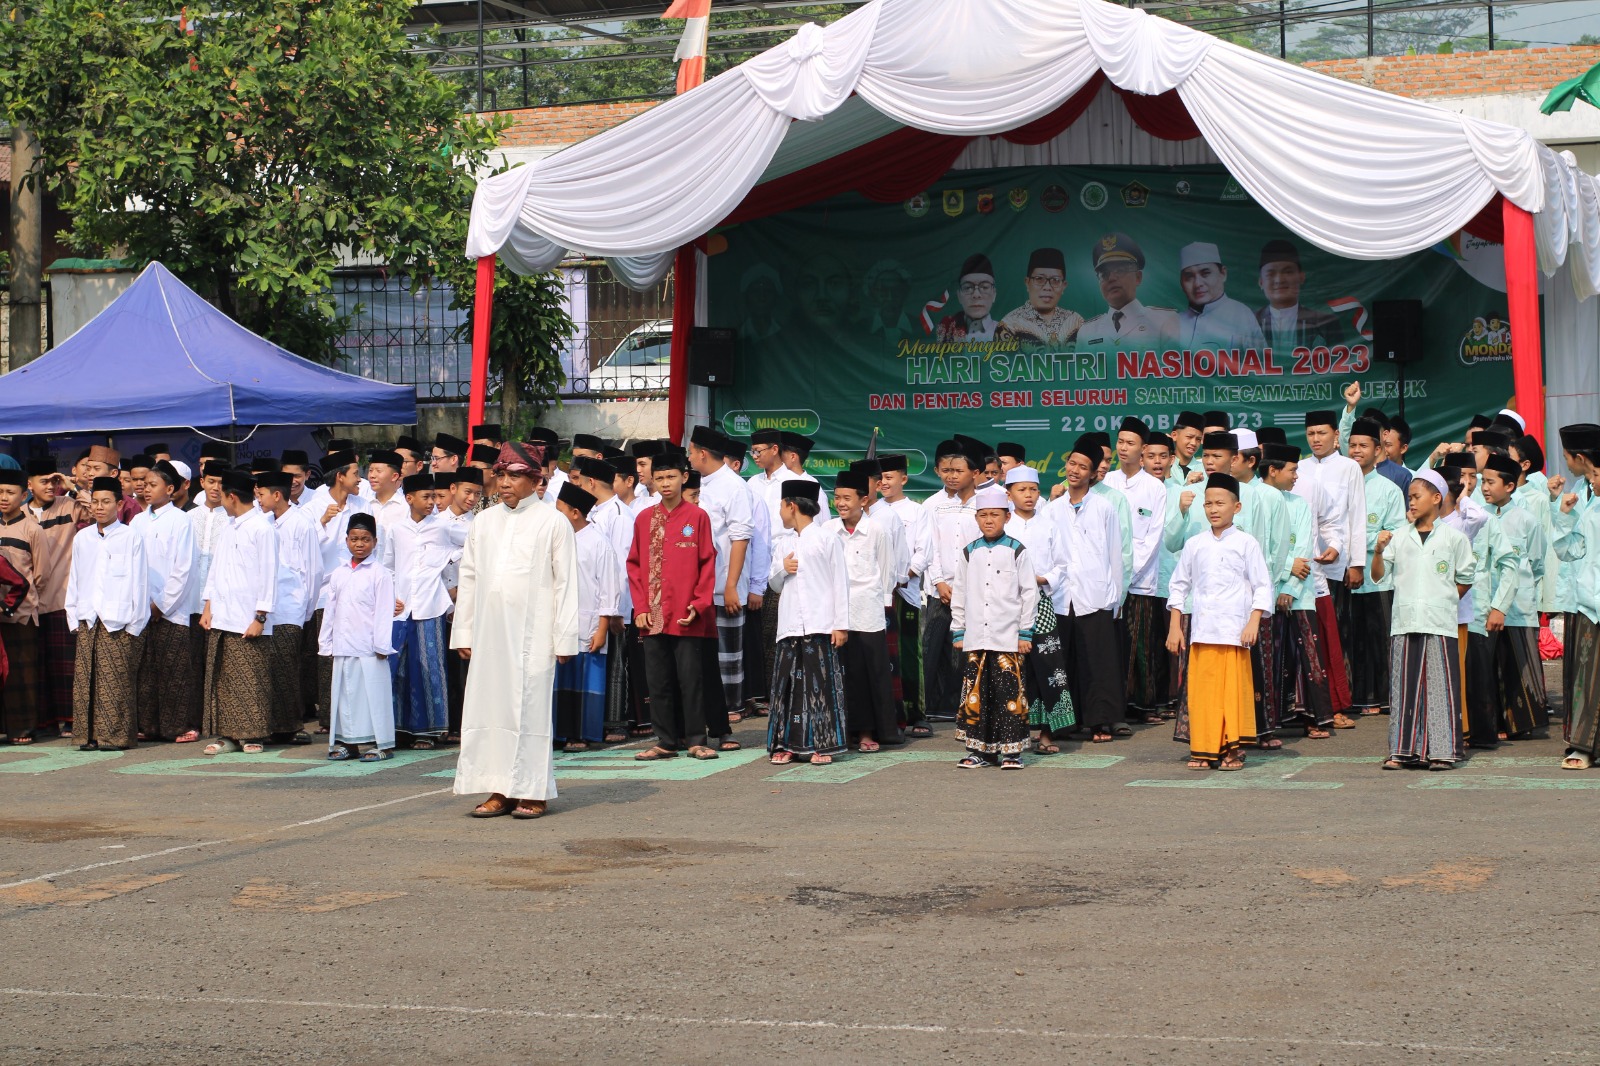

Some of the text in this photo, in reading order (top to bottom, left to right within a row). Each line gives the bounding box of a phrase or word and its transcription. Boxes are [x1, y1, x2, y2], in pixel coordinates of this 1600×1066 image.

[907, 345, 1370, 384] HARI SANTRI NASIONAL 2023
[869, 380, 1427, 410] DAN PENTAS SENI SELURUH SANTRI KECAMATAN CJERUK
[756, 417, 808, 429] MINGGU
[1061, 416, 1086, 432] 22
[802, 458, 824, 468] 7.30
[826, 458, 846, 468] WIB
